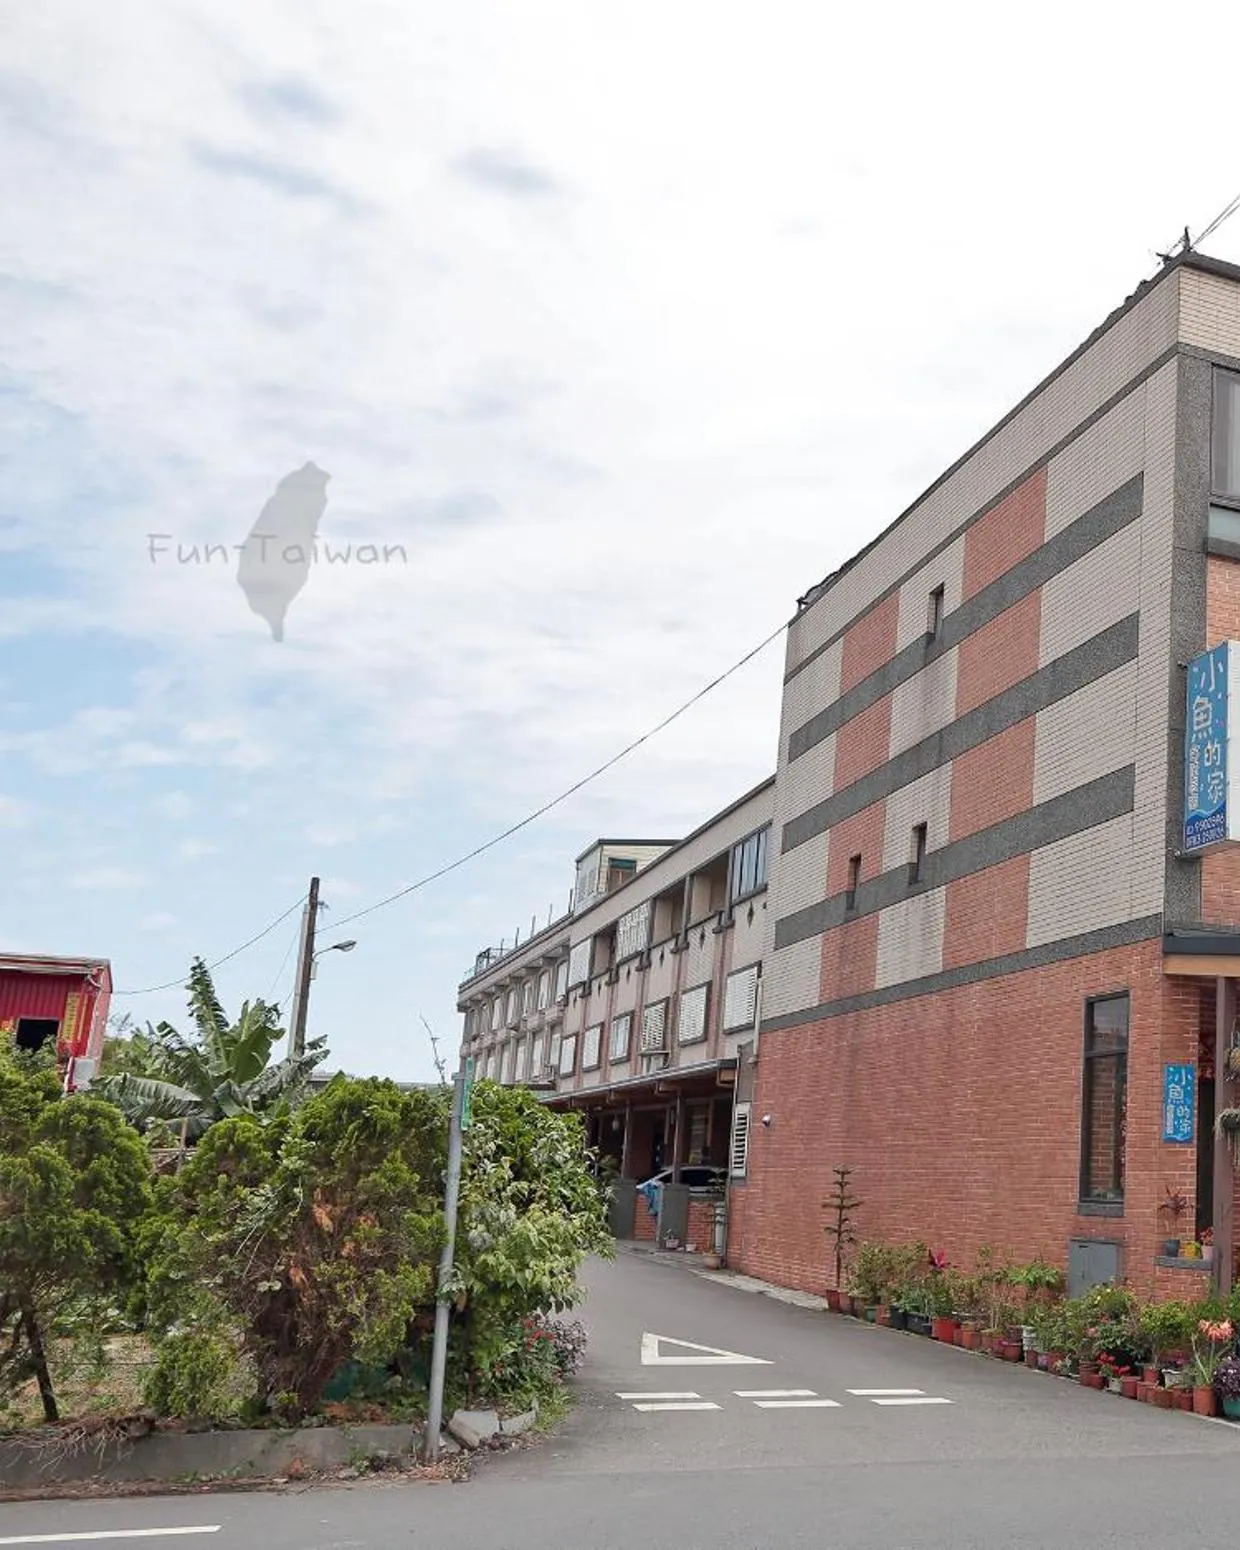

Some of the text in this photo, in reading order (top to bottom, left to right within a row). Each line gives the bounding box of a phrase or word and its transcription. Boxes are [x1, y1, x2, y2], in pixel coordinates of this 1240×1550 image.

[1191, 653, 1224, 804] 小魚的家
[1167, 1067, 1192, 1135] 小魚的家
